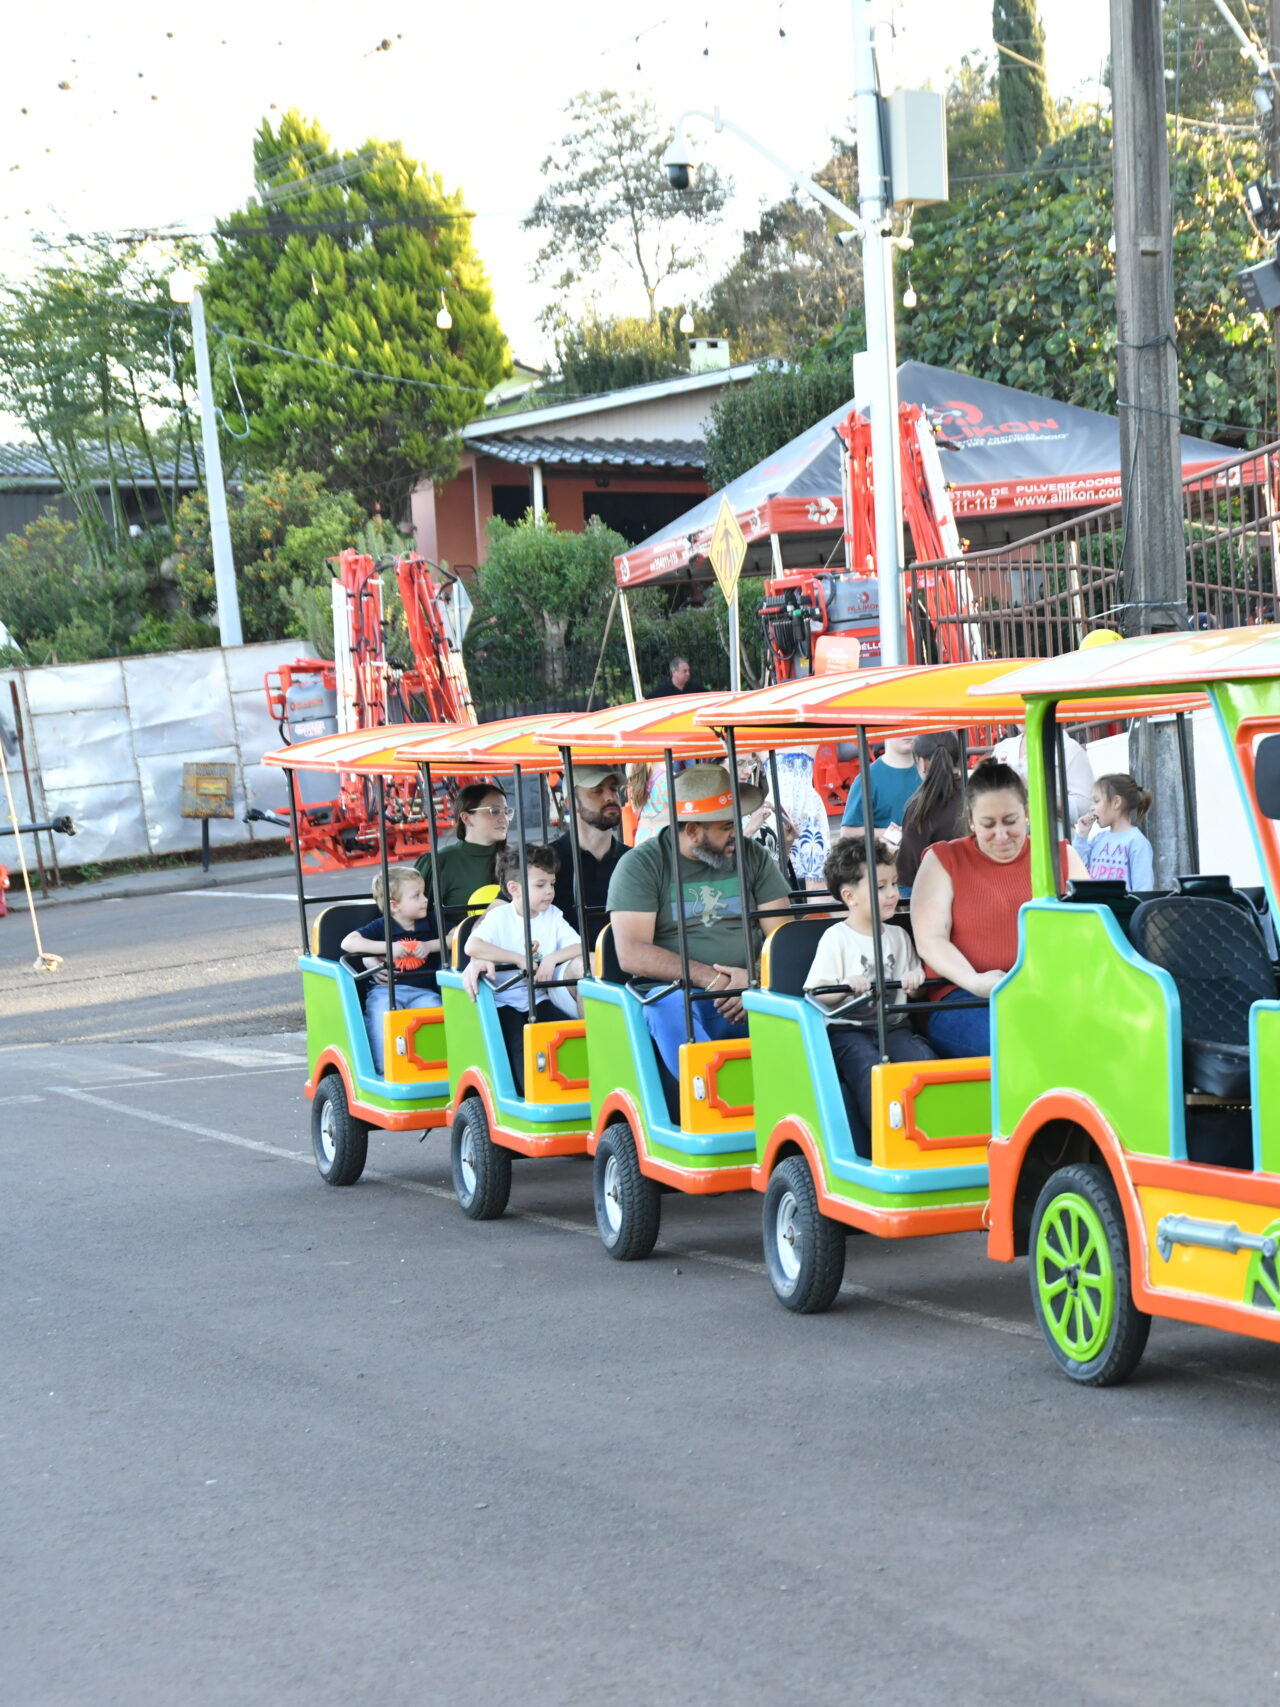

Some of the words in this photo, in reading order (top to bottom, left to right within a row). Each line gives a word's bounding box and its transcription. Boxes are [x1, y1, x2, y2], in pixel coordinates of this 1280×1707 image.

[933, 418, 1060, 441] LIKON
[949, 489, 985, 500] STRIA
[991, 486, 1009, 496] DE
[1015, 476, 1122, 494] PULVERIZADORE
[952, 496, 998, 513] 11-119
[1088, 863, 1126, 880] UPER
